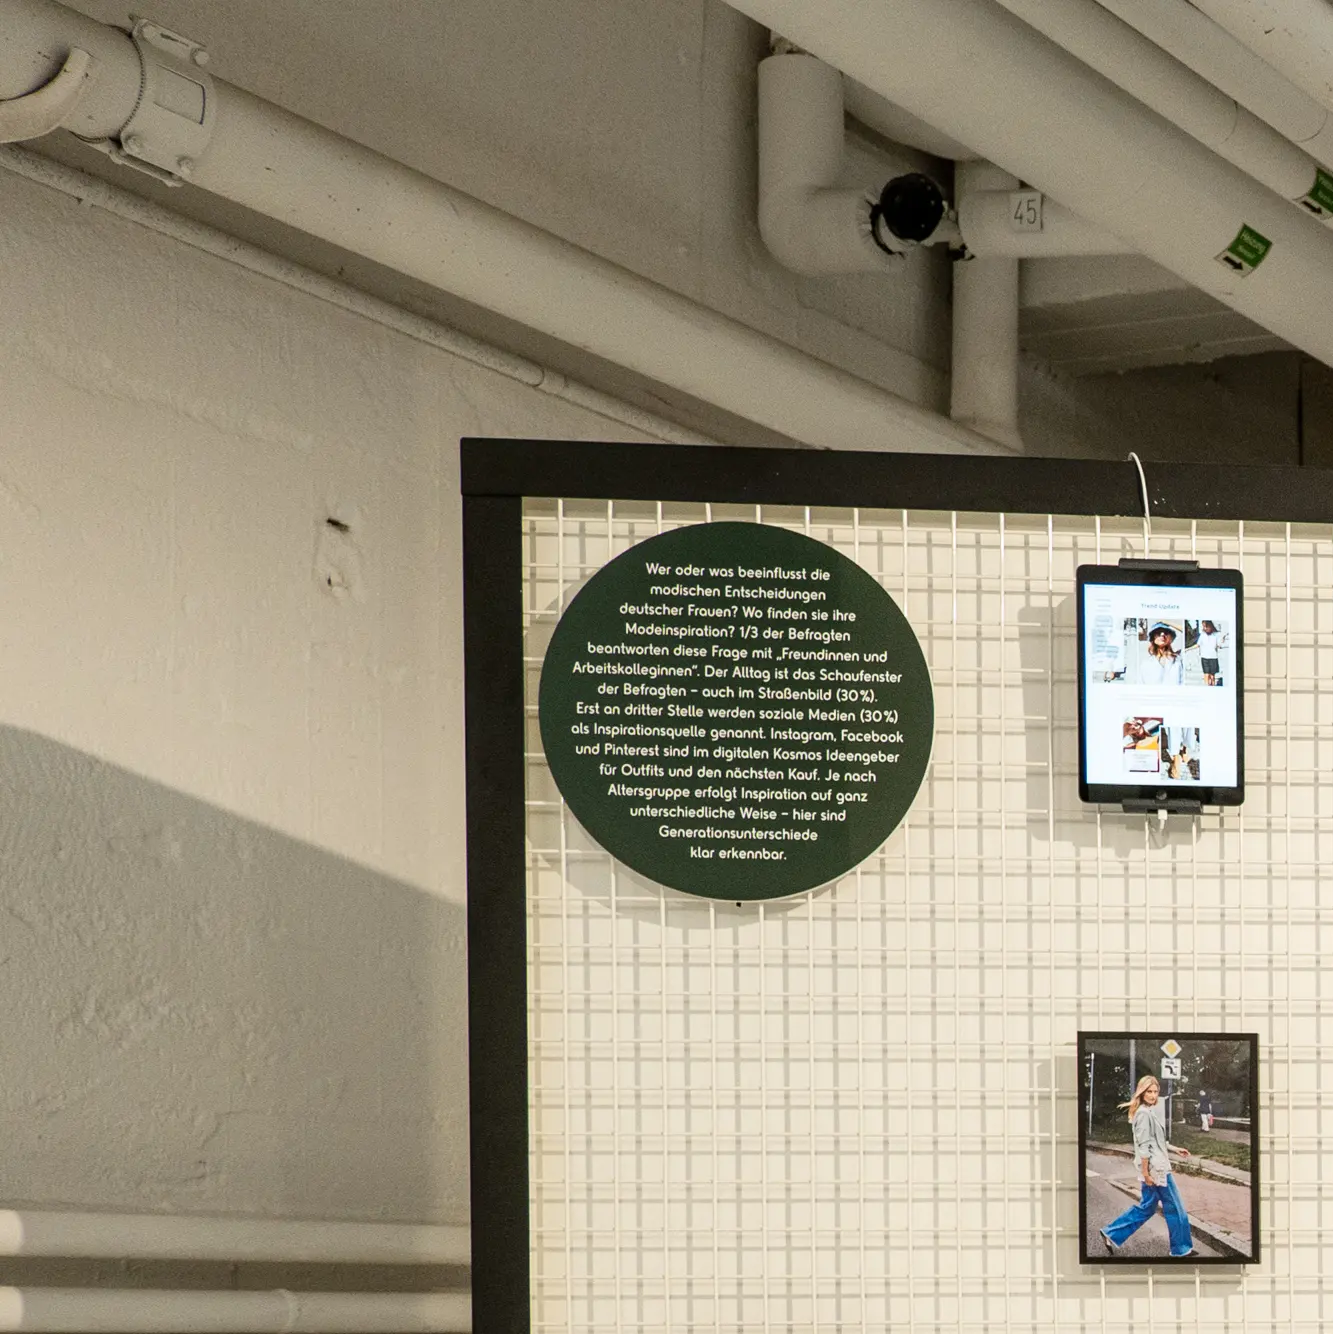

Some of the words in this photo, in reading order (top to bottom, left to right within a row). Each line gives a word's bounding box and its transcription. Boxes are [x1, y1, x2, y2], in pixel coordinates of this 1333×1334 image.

[1013, 199, 1037, 225] 45
[646, 563, 671, 575] Wer
[675, 564, 705, 576] oder
[709, 568, 734, 577] was
[738, 566, 806, 580] beeinflusst
[810, 569, 830, 581] die
[650, 584, 720, 597] modischen
[725, 585, 826, 603] Entscheidungen
[620, 602, 684, 616] deutscher
[688, 604, 738, 617] Frauen?
[742, 606, 763, 619] Wo
[767, 607, 807, 620] finden
[811, 609, 829, 621] sie
[833, 609, 856, 622] ihre
[626, 622, 735, 639] Modeinspiration?
[739, 625, 758, 639] 1/3
[763, 627, 784, 639] der
[788, 627, 850, 644] Befragten
[588, 642, 669, 655] beantworten
[673, 644, 707, 657] diese
[712, 645, 748, 661] Frage
[752, 647, 772, 659] mit
[863, 651, 888, 663] und
[705, 665, 728, 678] Der
[732, 666, 770, 682] Alltag
[775, 668, 789, 679] ist
[793, 668, 816, 680] das
[820, 668, 902, 683] Schaufenster
[597, 682, 619, 694] der
[624, 683, 686, 699] Befragten
[702, 686, 734, 698] auch
[739, 687, 754, 698] im
[758, 686, 832, 701] Straßenbild
[577, 702, 600, 714] Erst
[604, 706, 620, 715] an
[624, 703, 663, 716] dritter
[667, 704, 704, 717] Stelle
[708, 706, 755, 718] werden
[759, 708, 804, 720] soziale
[809, 708, 856, 721] Medien
[571, 722, 590, 734] als
[594, 723, 706, 740] Inspirationsquelle
[710, 727, 766, 741] genannt.
[771, 727, 837, 744] Instagram,
[841, 729, 904, 743] Facebook
[576, 743, 600, 755] und
[605, 743, 659, 756] Pinterest
[663, 745, 689, 757] sind
[693, 746, 709, 757] im
[713, 746, 769, 762] digitalen
[773, 748, 822, 761] Kosmos
[826, 749, 900, 765] Ideengeber
[599, 763, 617, 775] für
[621, 763, 664, 777] Outfits
[669, 766, 693, 777] und
[697, 766, 722, 778] den
[726, 767, 784, 780] nächsten
[788, 768, 820, 781] Kauf.
[825, 769, 840, 781] Je
[844, 770, 876, 782] nach
[608, 783, 690, 800] Altersgruppe
[694, 786, 737, 802] erfolgt
[741, 787, 807, 802] Inspiration
[811, 789, 832, 801] auf
[836, 792, 868, 805] ganz
[630, 805, 736, 819] unterschiedliche
[740, 807, 777, 820] Weise
[793, 808, 817, 821] hier
[820, 810, 846, 821] sind
[659, 825, 818, 841] Generationsunterschiede
[690, 846, 715, 858] klar
[719, 847, 787, 860] erkennbar.
